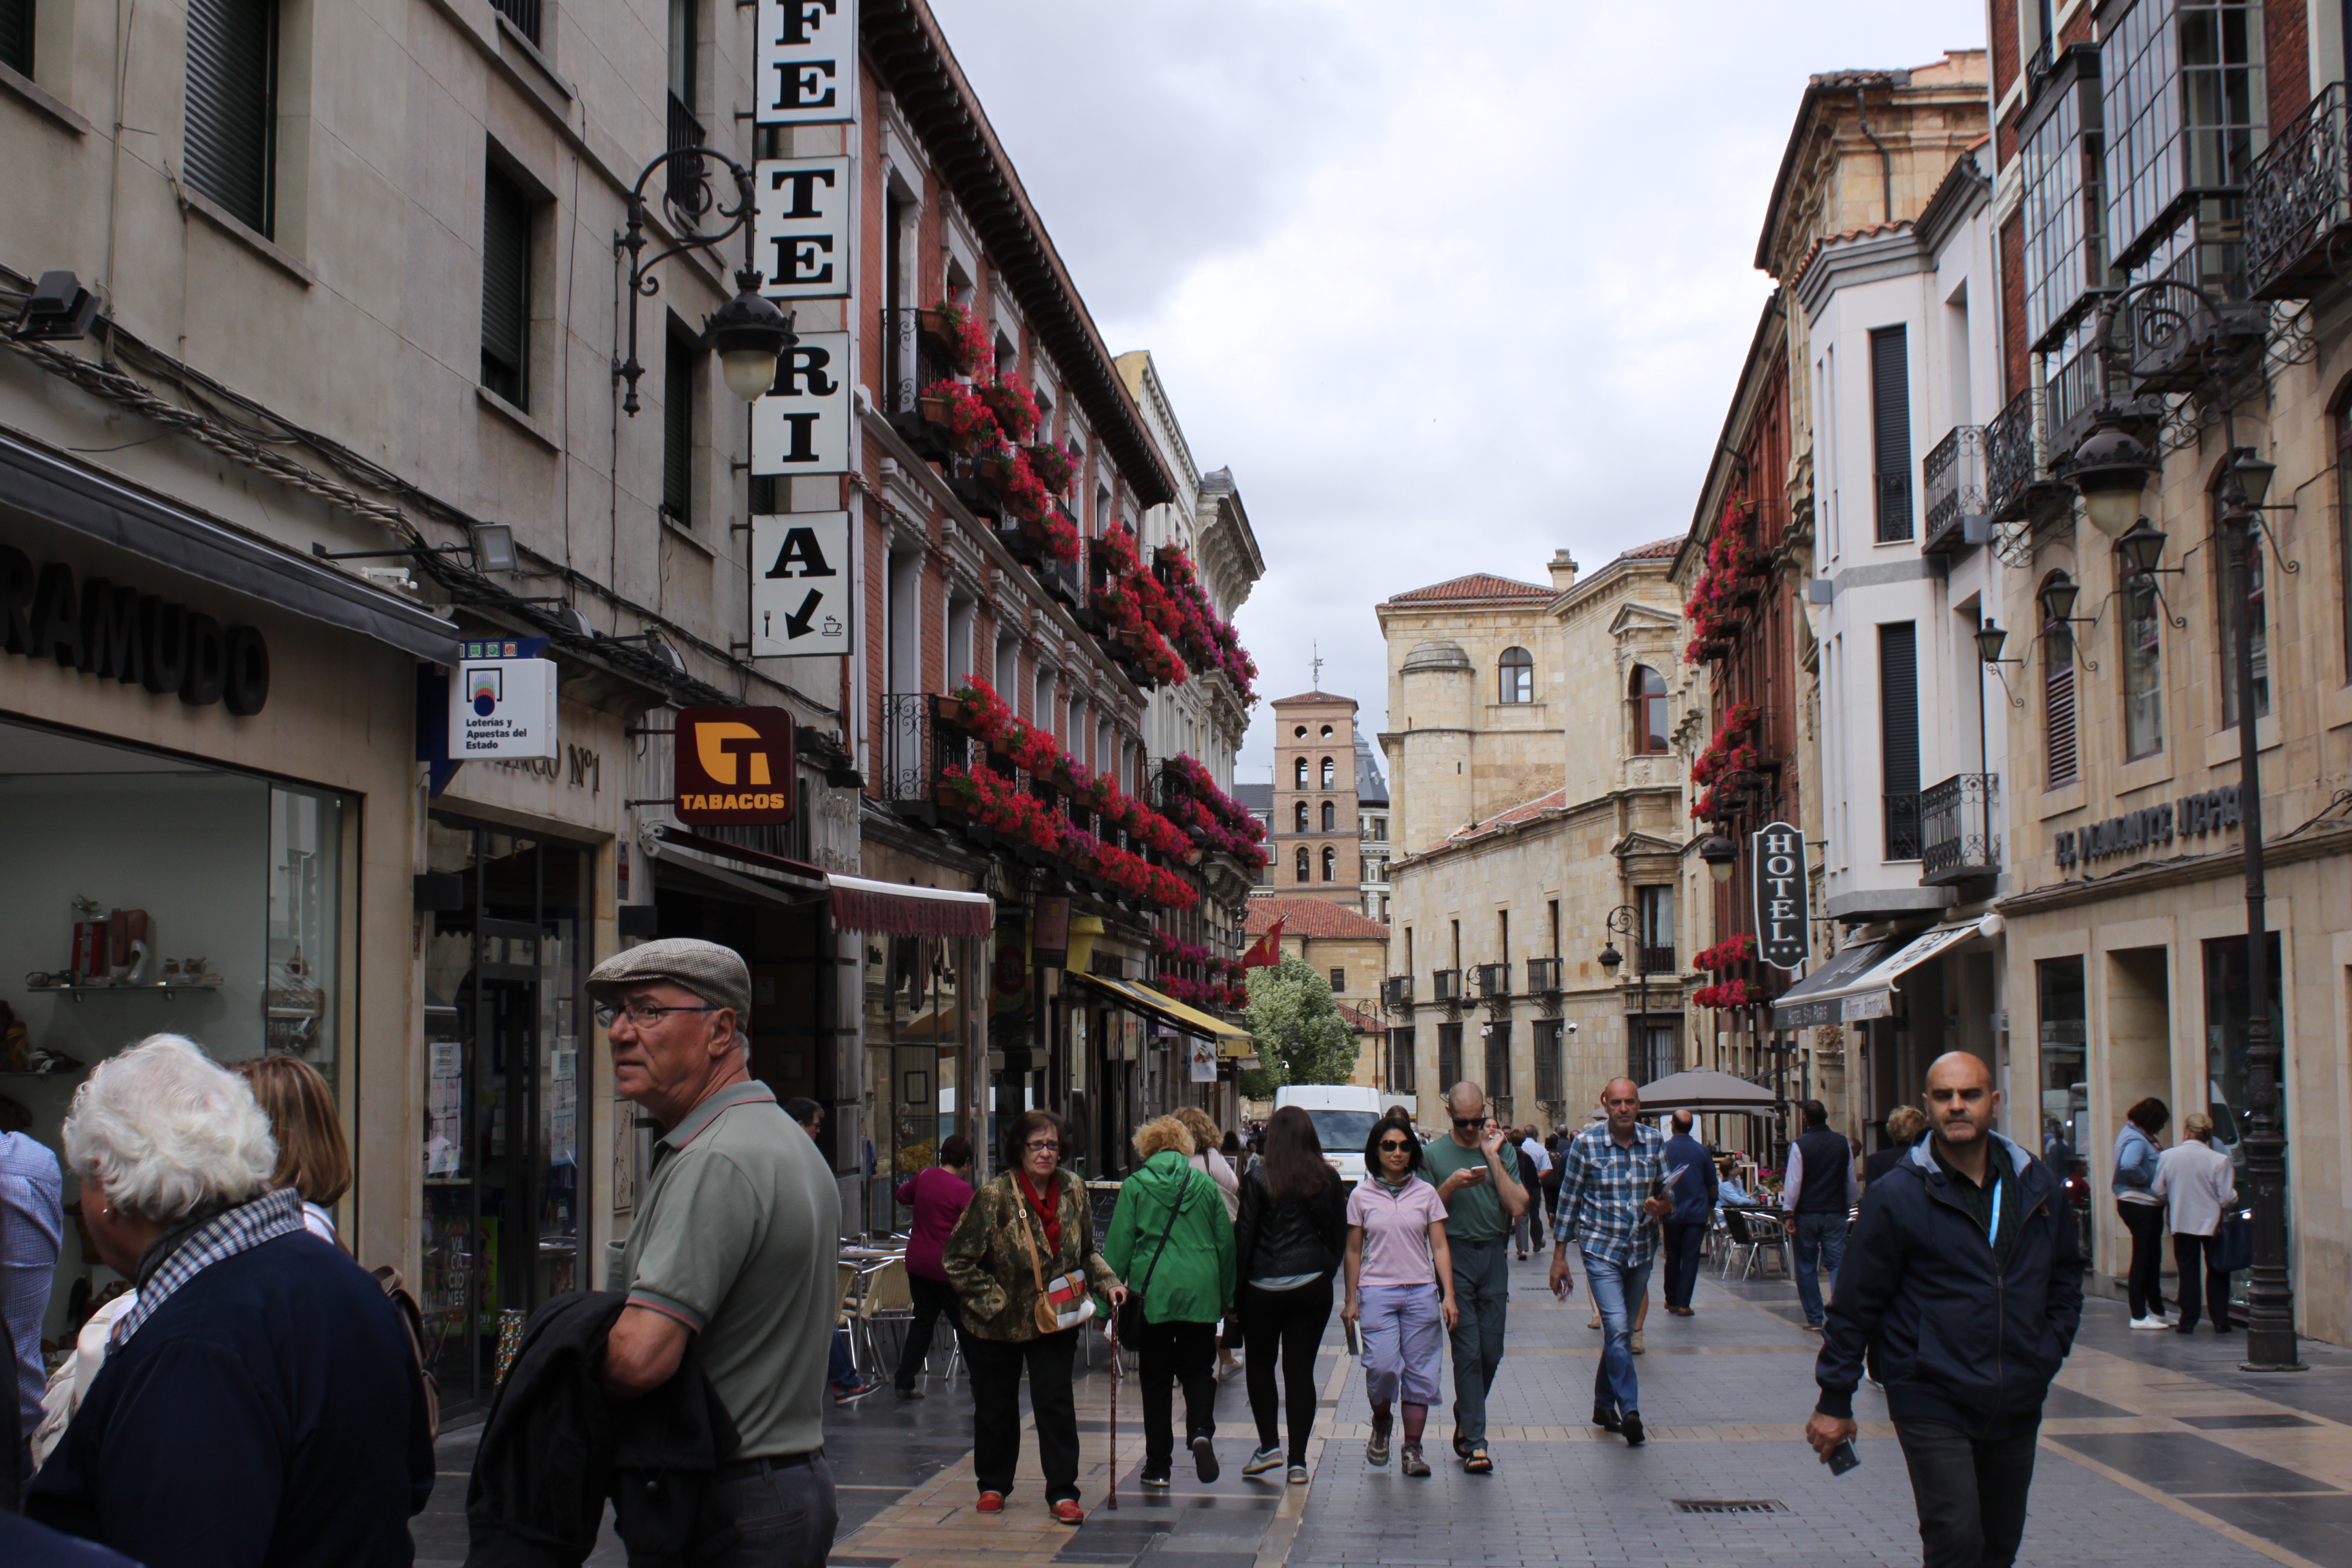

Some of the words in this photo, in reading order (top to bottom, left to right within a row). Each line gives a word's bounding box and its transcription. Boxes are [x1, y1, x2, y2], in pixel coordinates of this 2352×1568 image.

[0, 544, 270, 716] RAMUDO
[466, 717, 504, 728] Loterías
[506, 719, 512, 728] y
[466, 729, 510, 740] Apuestas
[512, 728, 527, 737] del
[466, 740, 498, 749] Estado
[681, 794, 785, 810] TABACOS
[2055, 831, 2077, 866] EL
[2078, 802, 2173, 860] DIAMANTE
[1765, 834, 1799, 943] HOTEL
[447, 1290, 465, 1307] NES
